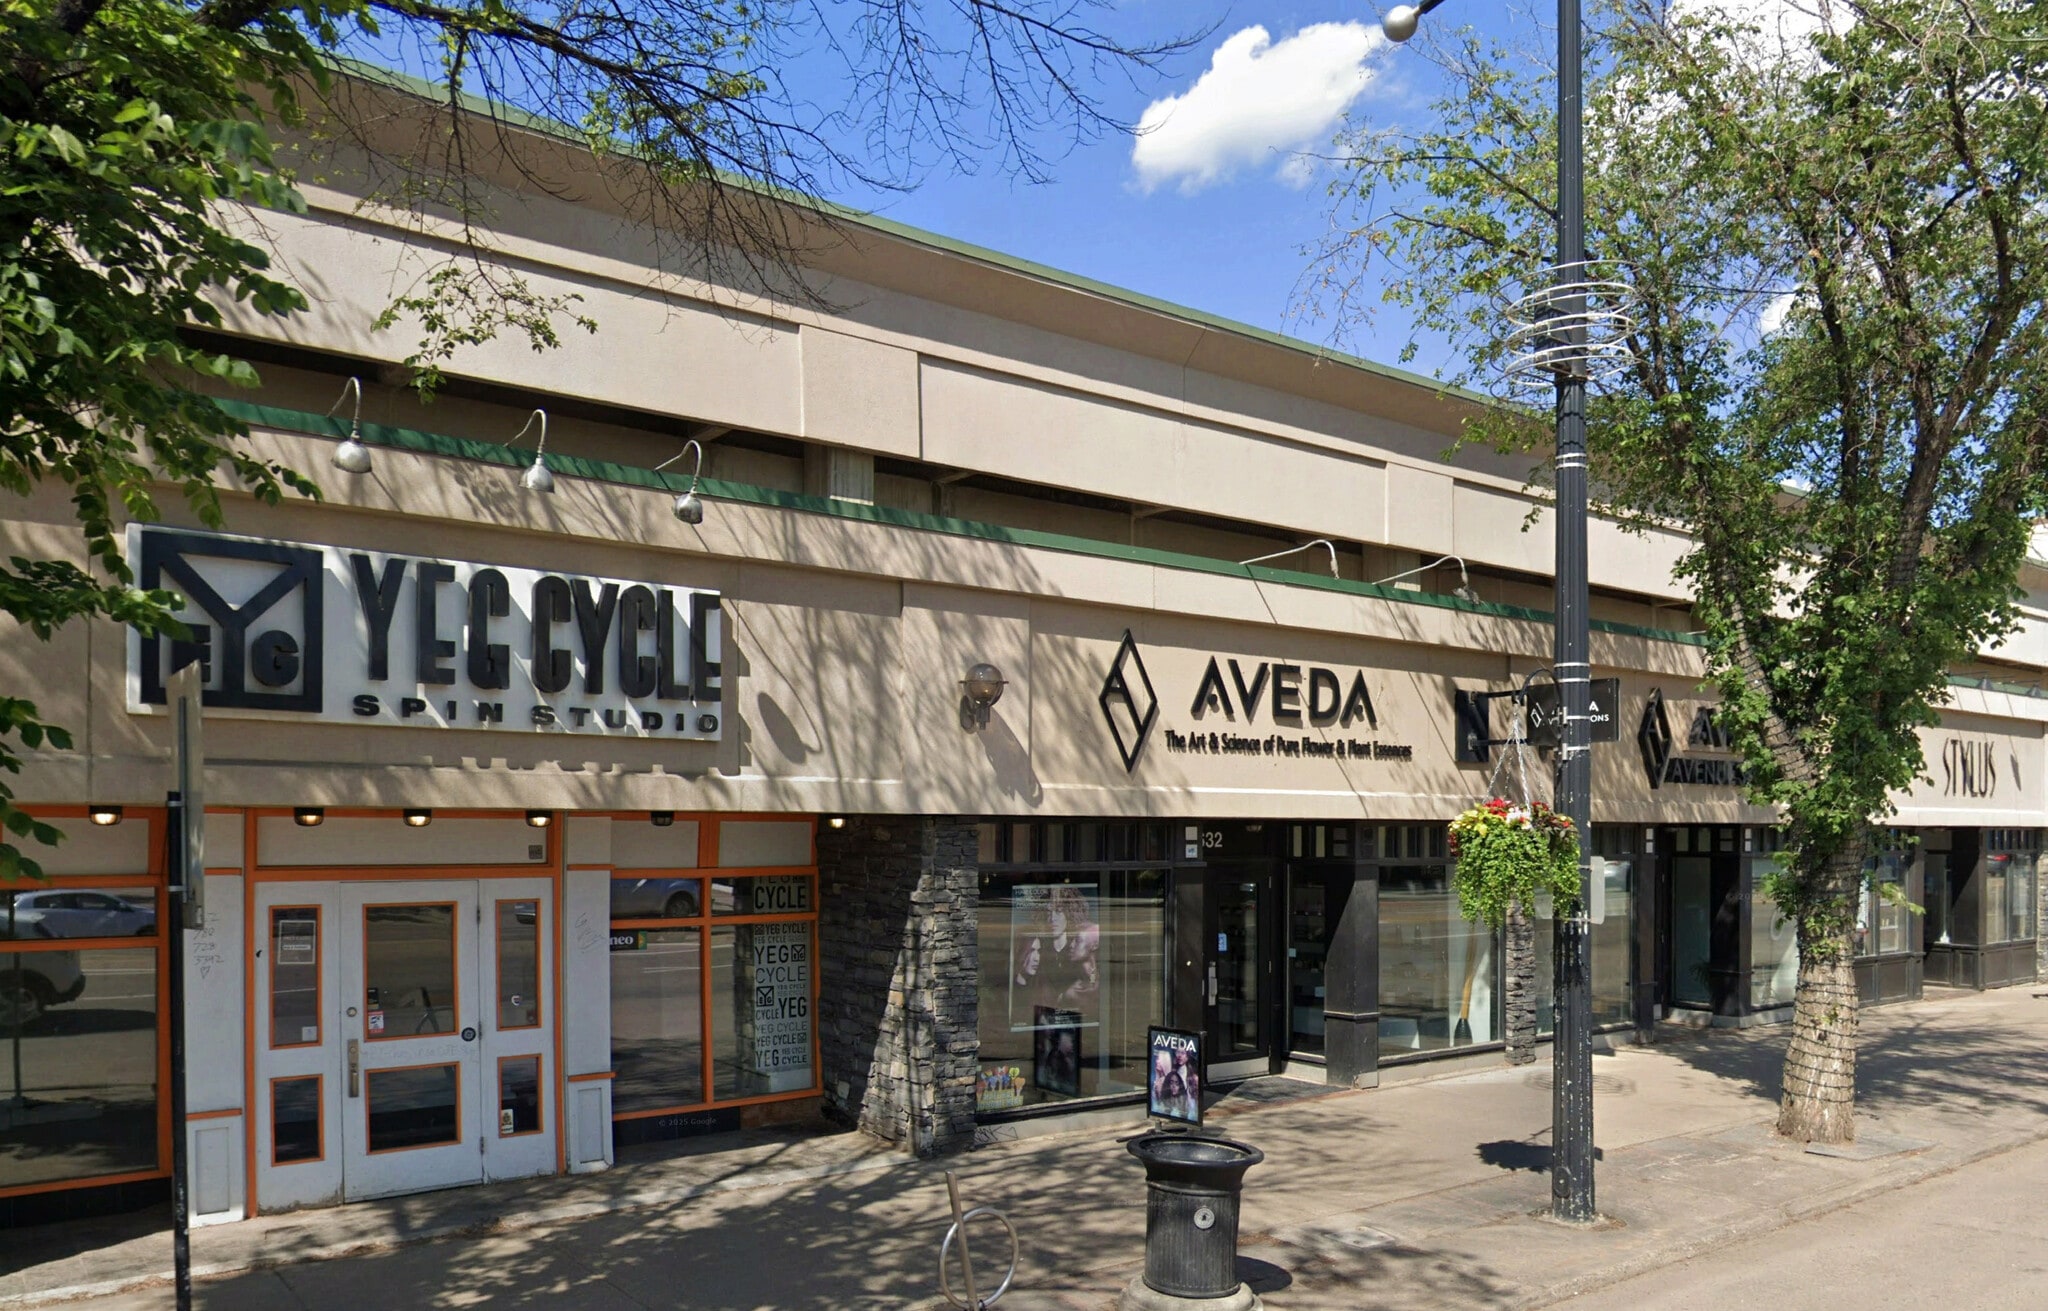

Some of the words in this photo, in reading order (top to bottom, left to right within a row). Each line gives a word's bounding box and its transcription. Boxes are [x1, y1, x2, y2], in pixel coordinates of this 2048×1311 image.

[350, 553, 511, 692] YEG
[531, 575, 722, 702] CYCLE
[1190, 656, 1378, 728] AVEDA
[353, 694, 504, 723] SPIN
[531, 704, 720, 734] STUDIO
[1165, 730, 1186, 749] The
[1188, 731, 1207, 750] Art
[1209, 732, 1220, 750] &
[1221, 732, 1261, 752] Science
[1263, 735, 1275, 752] of
[1276, 735, 1300, 754] Pure
[1337, 739, 1346, 755] &
[1347, 739, 1371, 756] Plant
[1373, 741, 1413, 759] Essences
[1943, 737, 1996, 798] STYLUS
[755, 885, 806, 909] CYCLE
[766, 923, 780, 935] YEG
[782, 922, 807, 934] CYCLE
[610, 936, 634, 945] neo
[755, 945, 789, 965] YEG
[755, 966, 807, 983] CYCLE
[756, 1008, 779, 1020] CYCLE
[778, 997, 807, 1019] YEG
[756, 1023, 774, 1034] YEG
[777, 1021, 807, 1032] CYCLE
[757, 1036, 771, 1047] YEG
[772, 1033, 796, 1046] CYCLE
[1154, 1034, 1196, 1052] AVEDA
[756, 1049, 779, 1067] YEG
[781, 1055, 807, 1065] CYCLE
